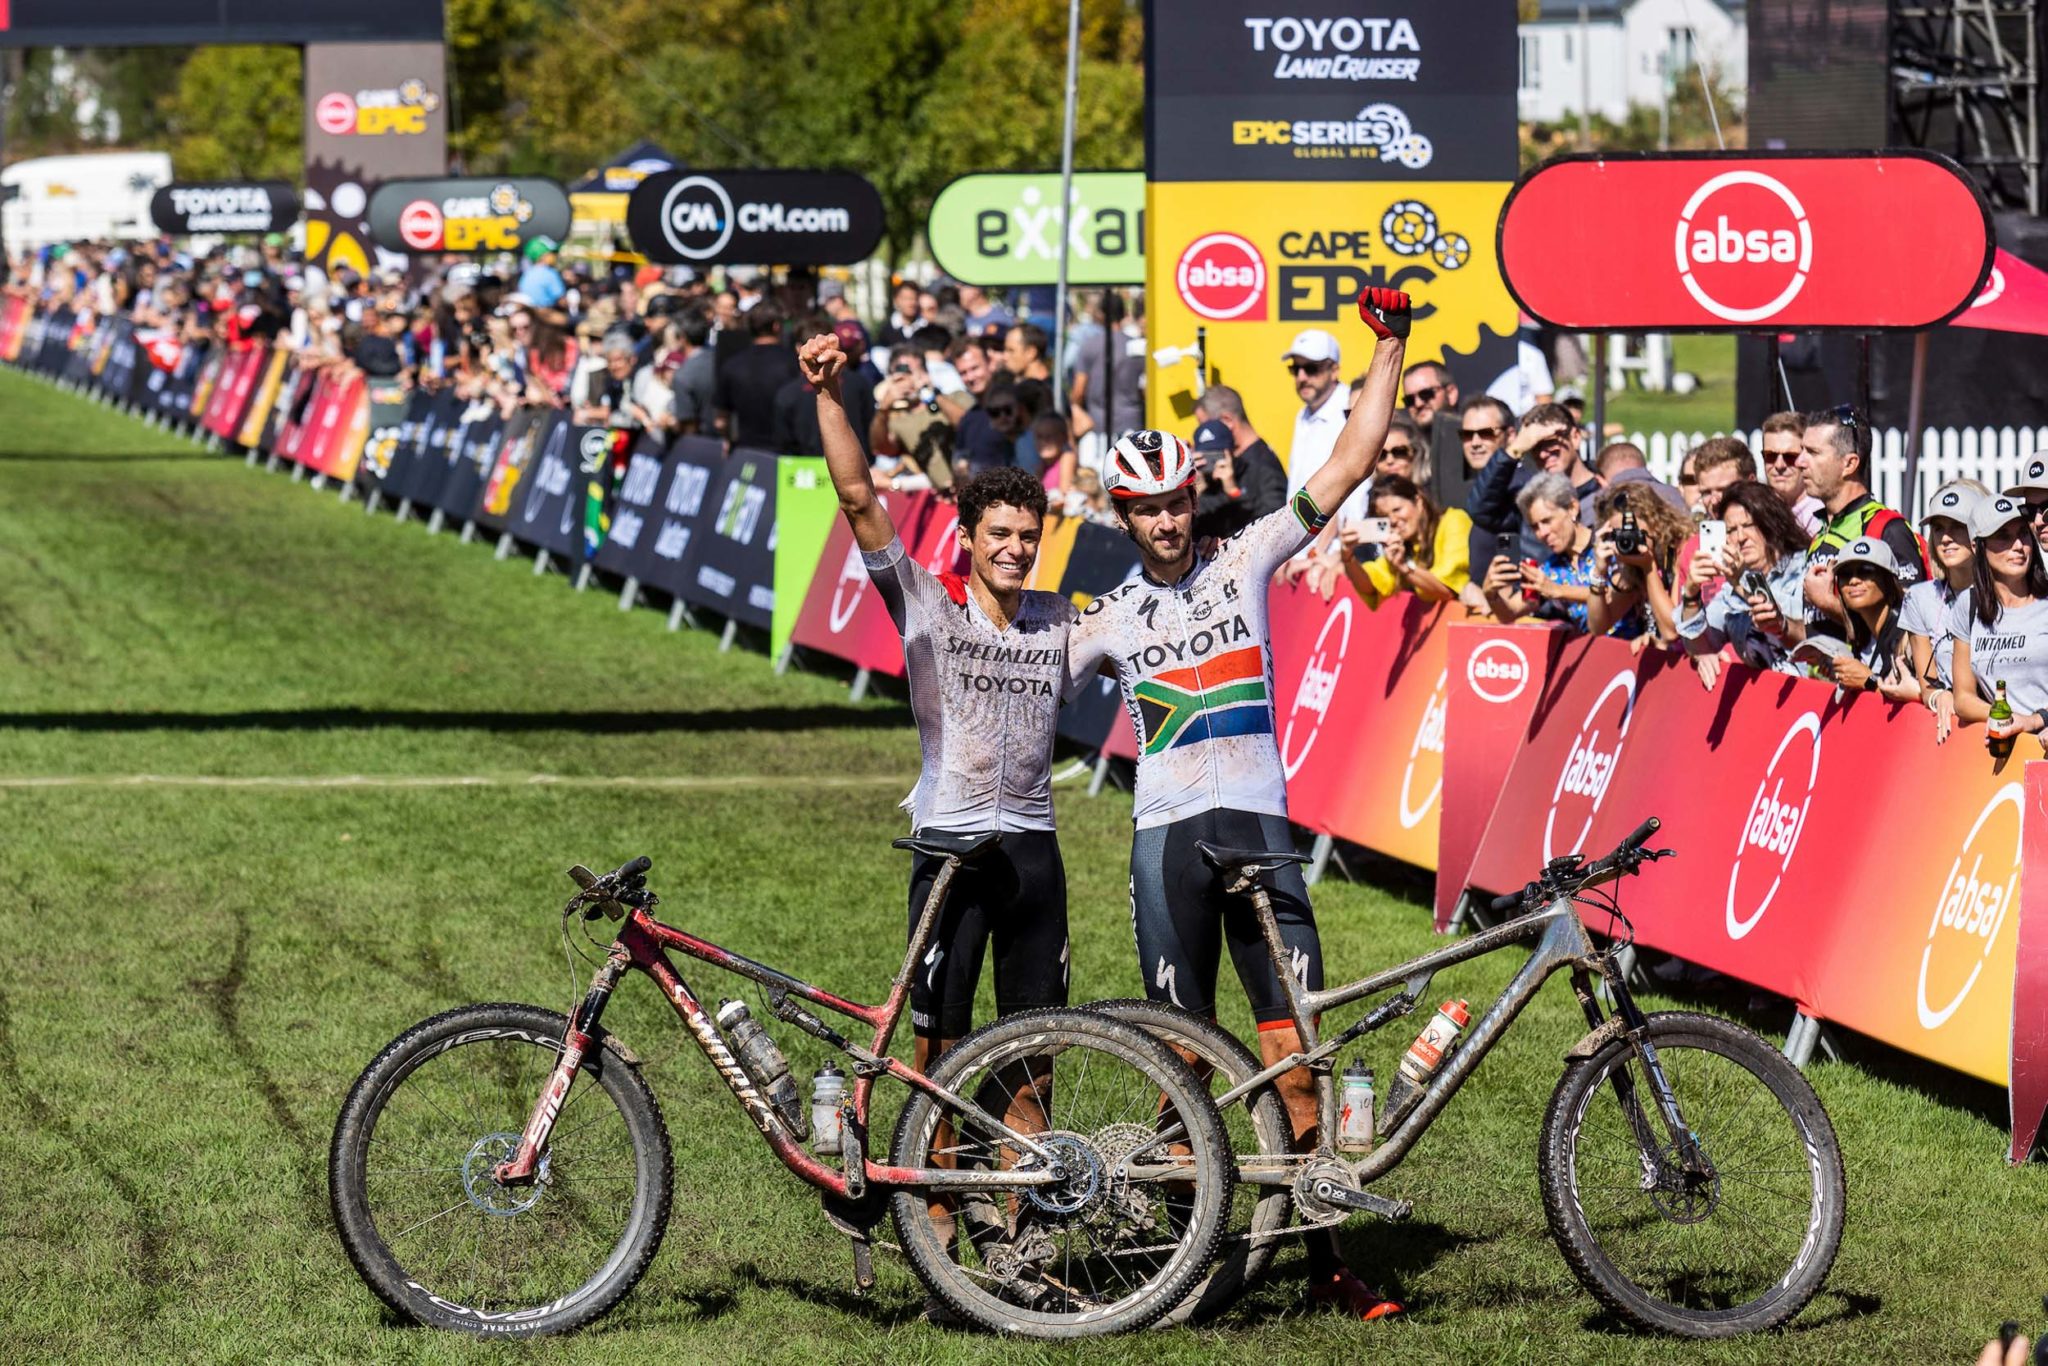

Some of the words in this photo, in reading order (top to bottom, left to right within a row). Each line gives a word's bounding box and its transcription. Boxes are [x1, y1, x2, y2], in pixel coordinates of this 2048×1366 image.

[1245, 18, 1420, 51] TOYOTA
[1294, 147, 1345, 158] GLOBAL
[169, 187, 272, 215] TOYOTA
[737, 202, 849, 232] CM.com
[1279, 232, 1370, 259] CAPE
[1692, 215, 1796, 263] absa
[1188, 259, 1256, 287] absa
[944, 635, 1061, 666] SPECIALIZED
[1127, 614, 1251, 675] TOYOTA
[1974, 635, 2026, 653] UNTAMED
[1475, 657, 1522, 680] absa
[959, 672, 1053, 697] TOYOTA
[1564, 730, 1613, 798] absa
[1749, 777, 1800, 855] absa
[1942, 853, 2004, 938] absa
[1149, 1258, 1192, 1304] RENEGADE
[482, 1323, 510, 1332] TRAK
[513, 1320, 542, 1331] FAST
